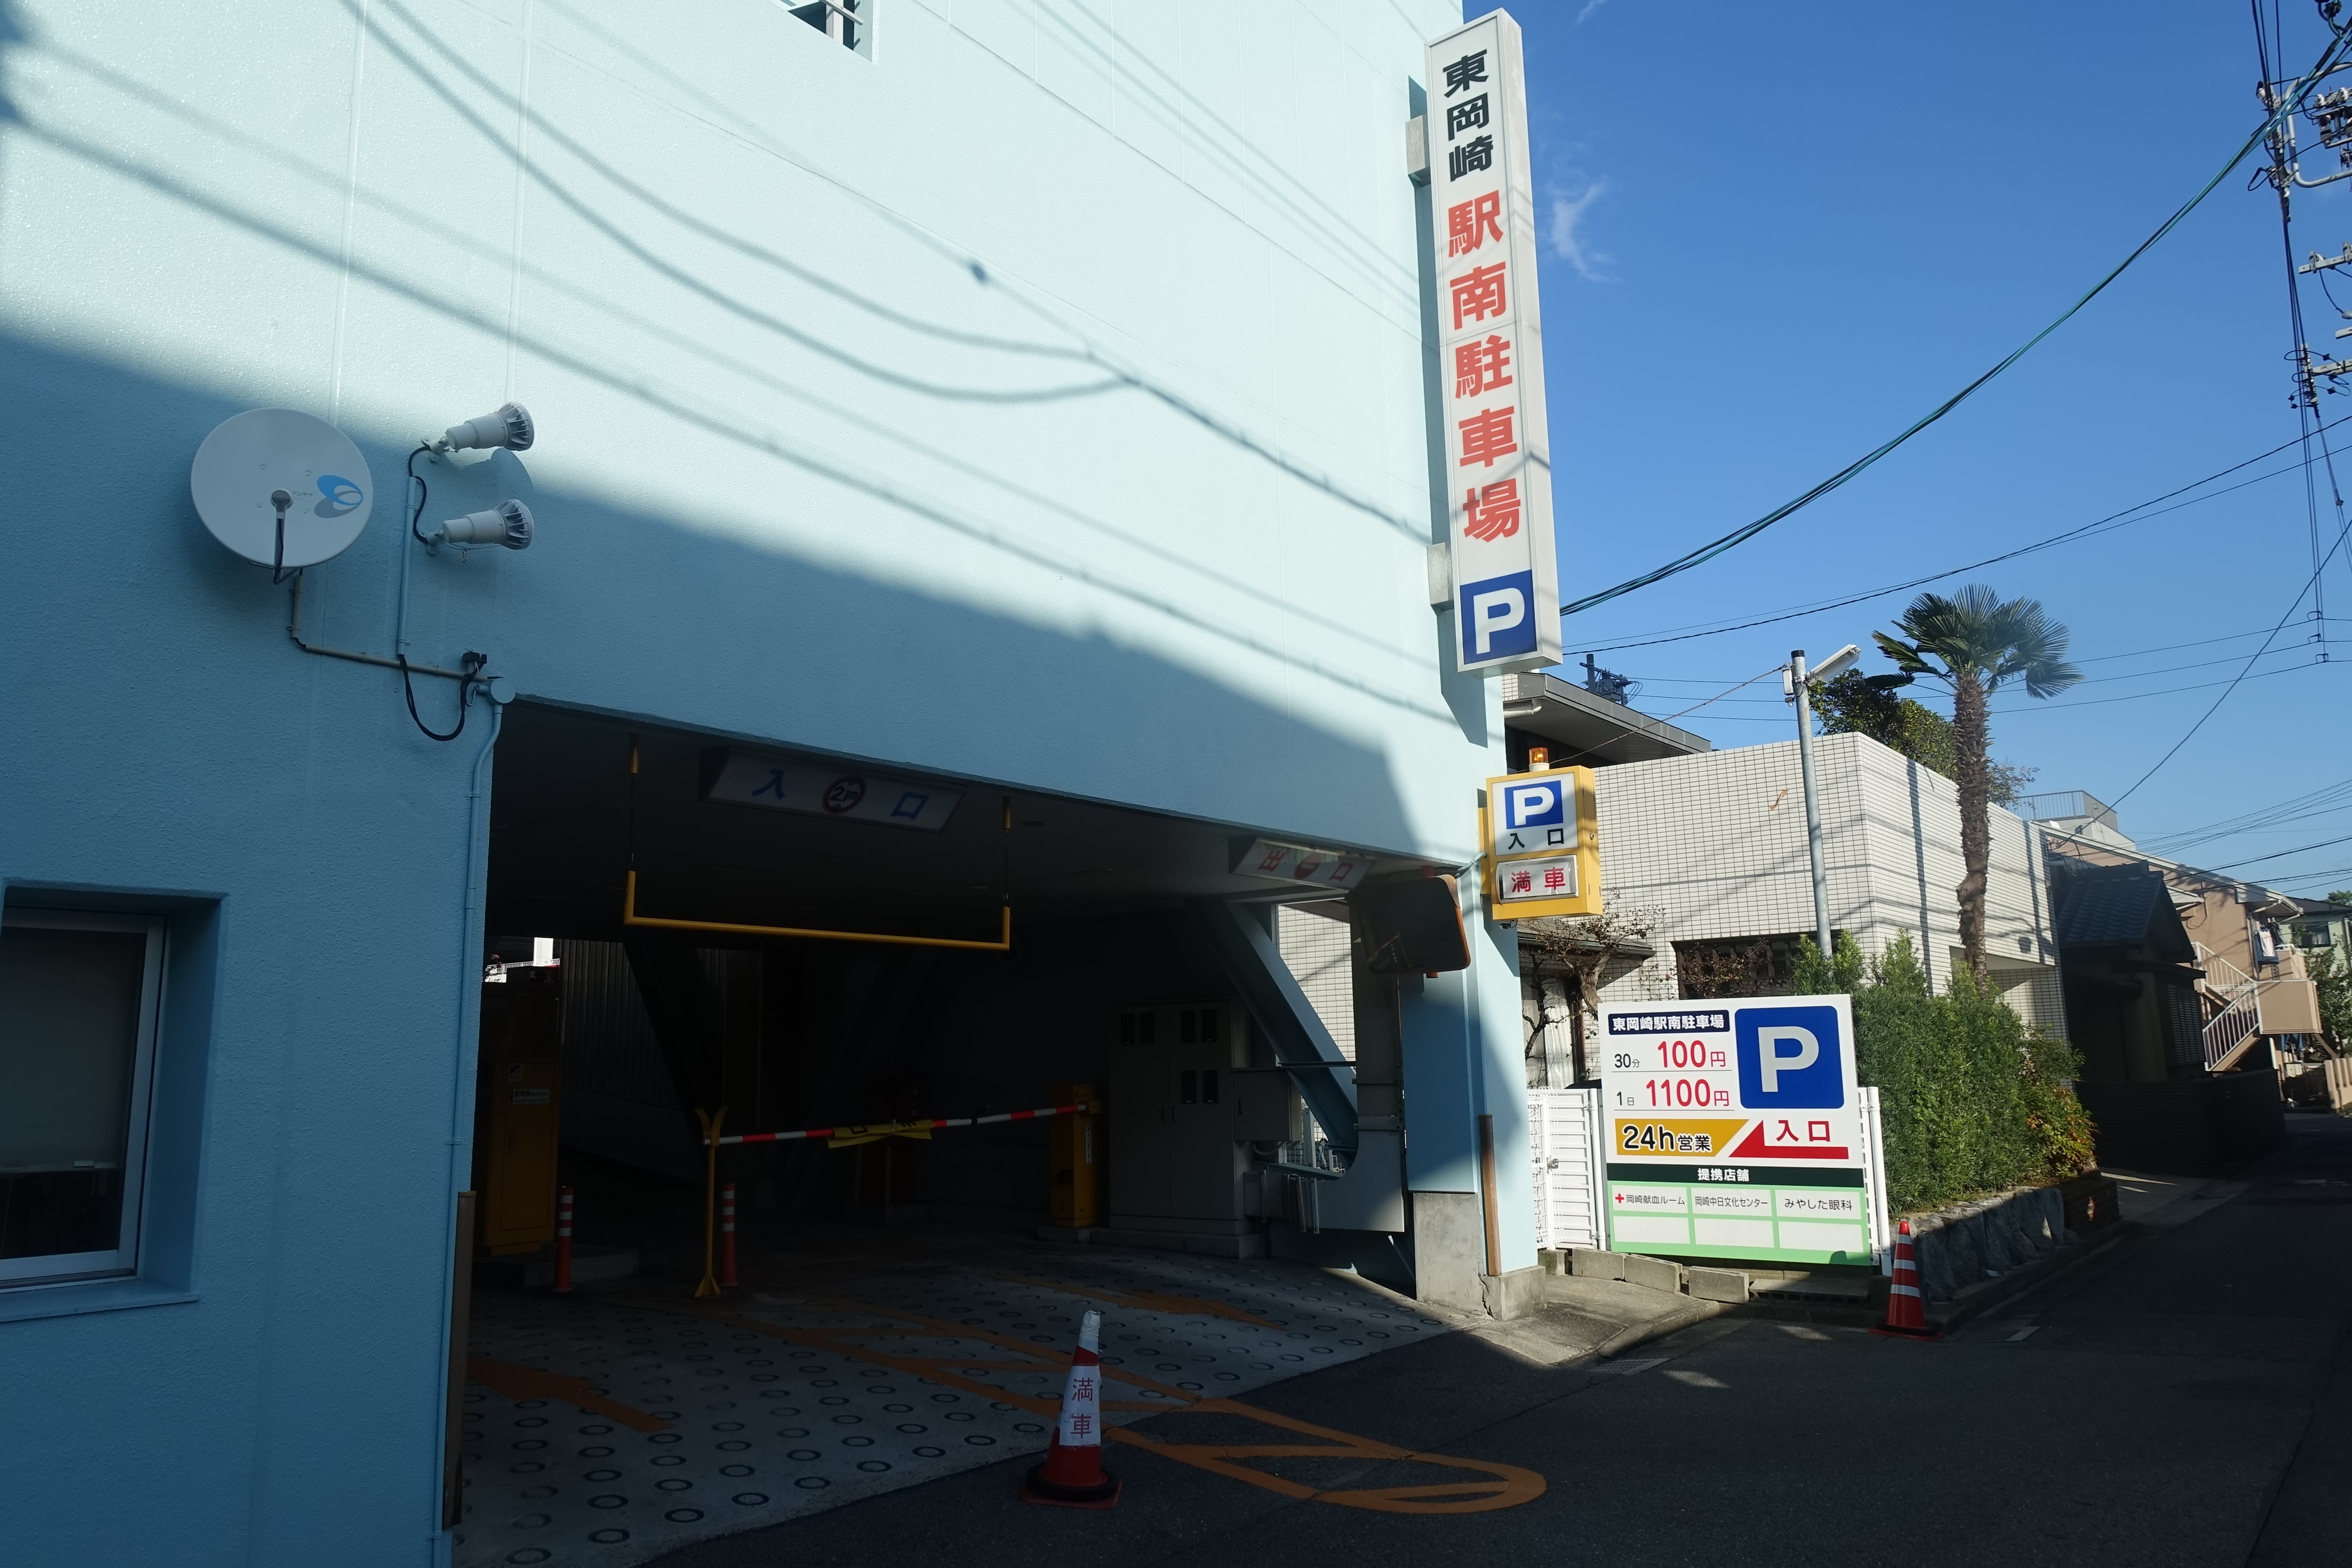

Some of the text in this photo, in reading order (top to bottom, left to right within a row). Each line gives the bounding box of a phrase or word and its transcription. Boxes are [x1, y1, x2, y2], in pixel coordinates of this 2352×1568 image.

[1442, 49, 1521, 542] 東岡崎駅南駐車場
[1473, 587, 1525, 655] P
[829, 786, 860, 802] 2.1m
[1513, 786, 1554, 826] P
[1508, 828, 1564, 850] 入口
[1511, 867, 1566, 893] 満車
[1612, 1014, 1724, 1031] 東岡崎駅南駐車場
[1614, 1040, 1726, 1068] 30分 100円
[1758, 1026, 1819, 1092] P
[1617, 1079, 1729, 1106] 1日 1100円
[1623, 1125, 1711, 1152] 24h営業
[1776, 1120, 1831, 1142] 入口
[1697, 1168, 1750, 1182] 提携店舗
[1626, 1194, 1685, 1205] 岡崎献血ルーム
[1695, 1196, 1768, 1208] 岡崎中日文化センター
[1784, 1198, 1853, 1211] みやした眼科
[1070, 1378, 1094, 1439] 満車
